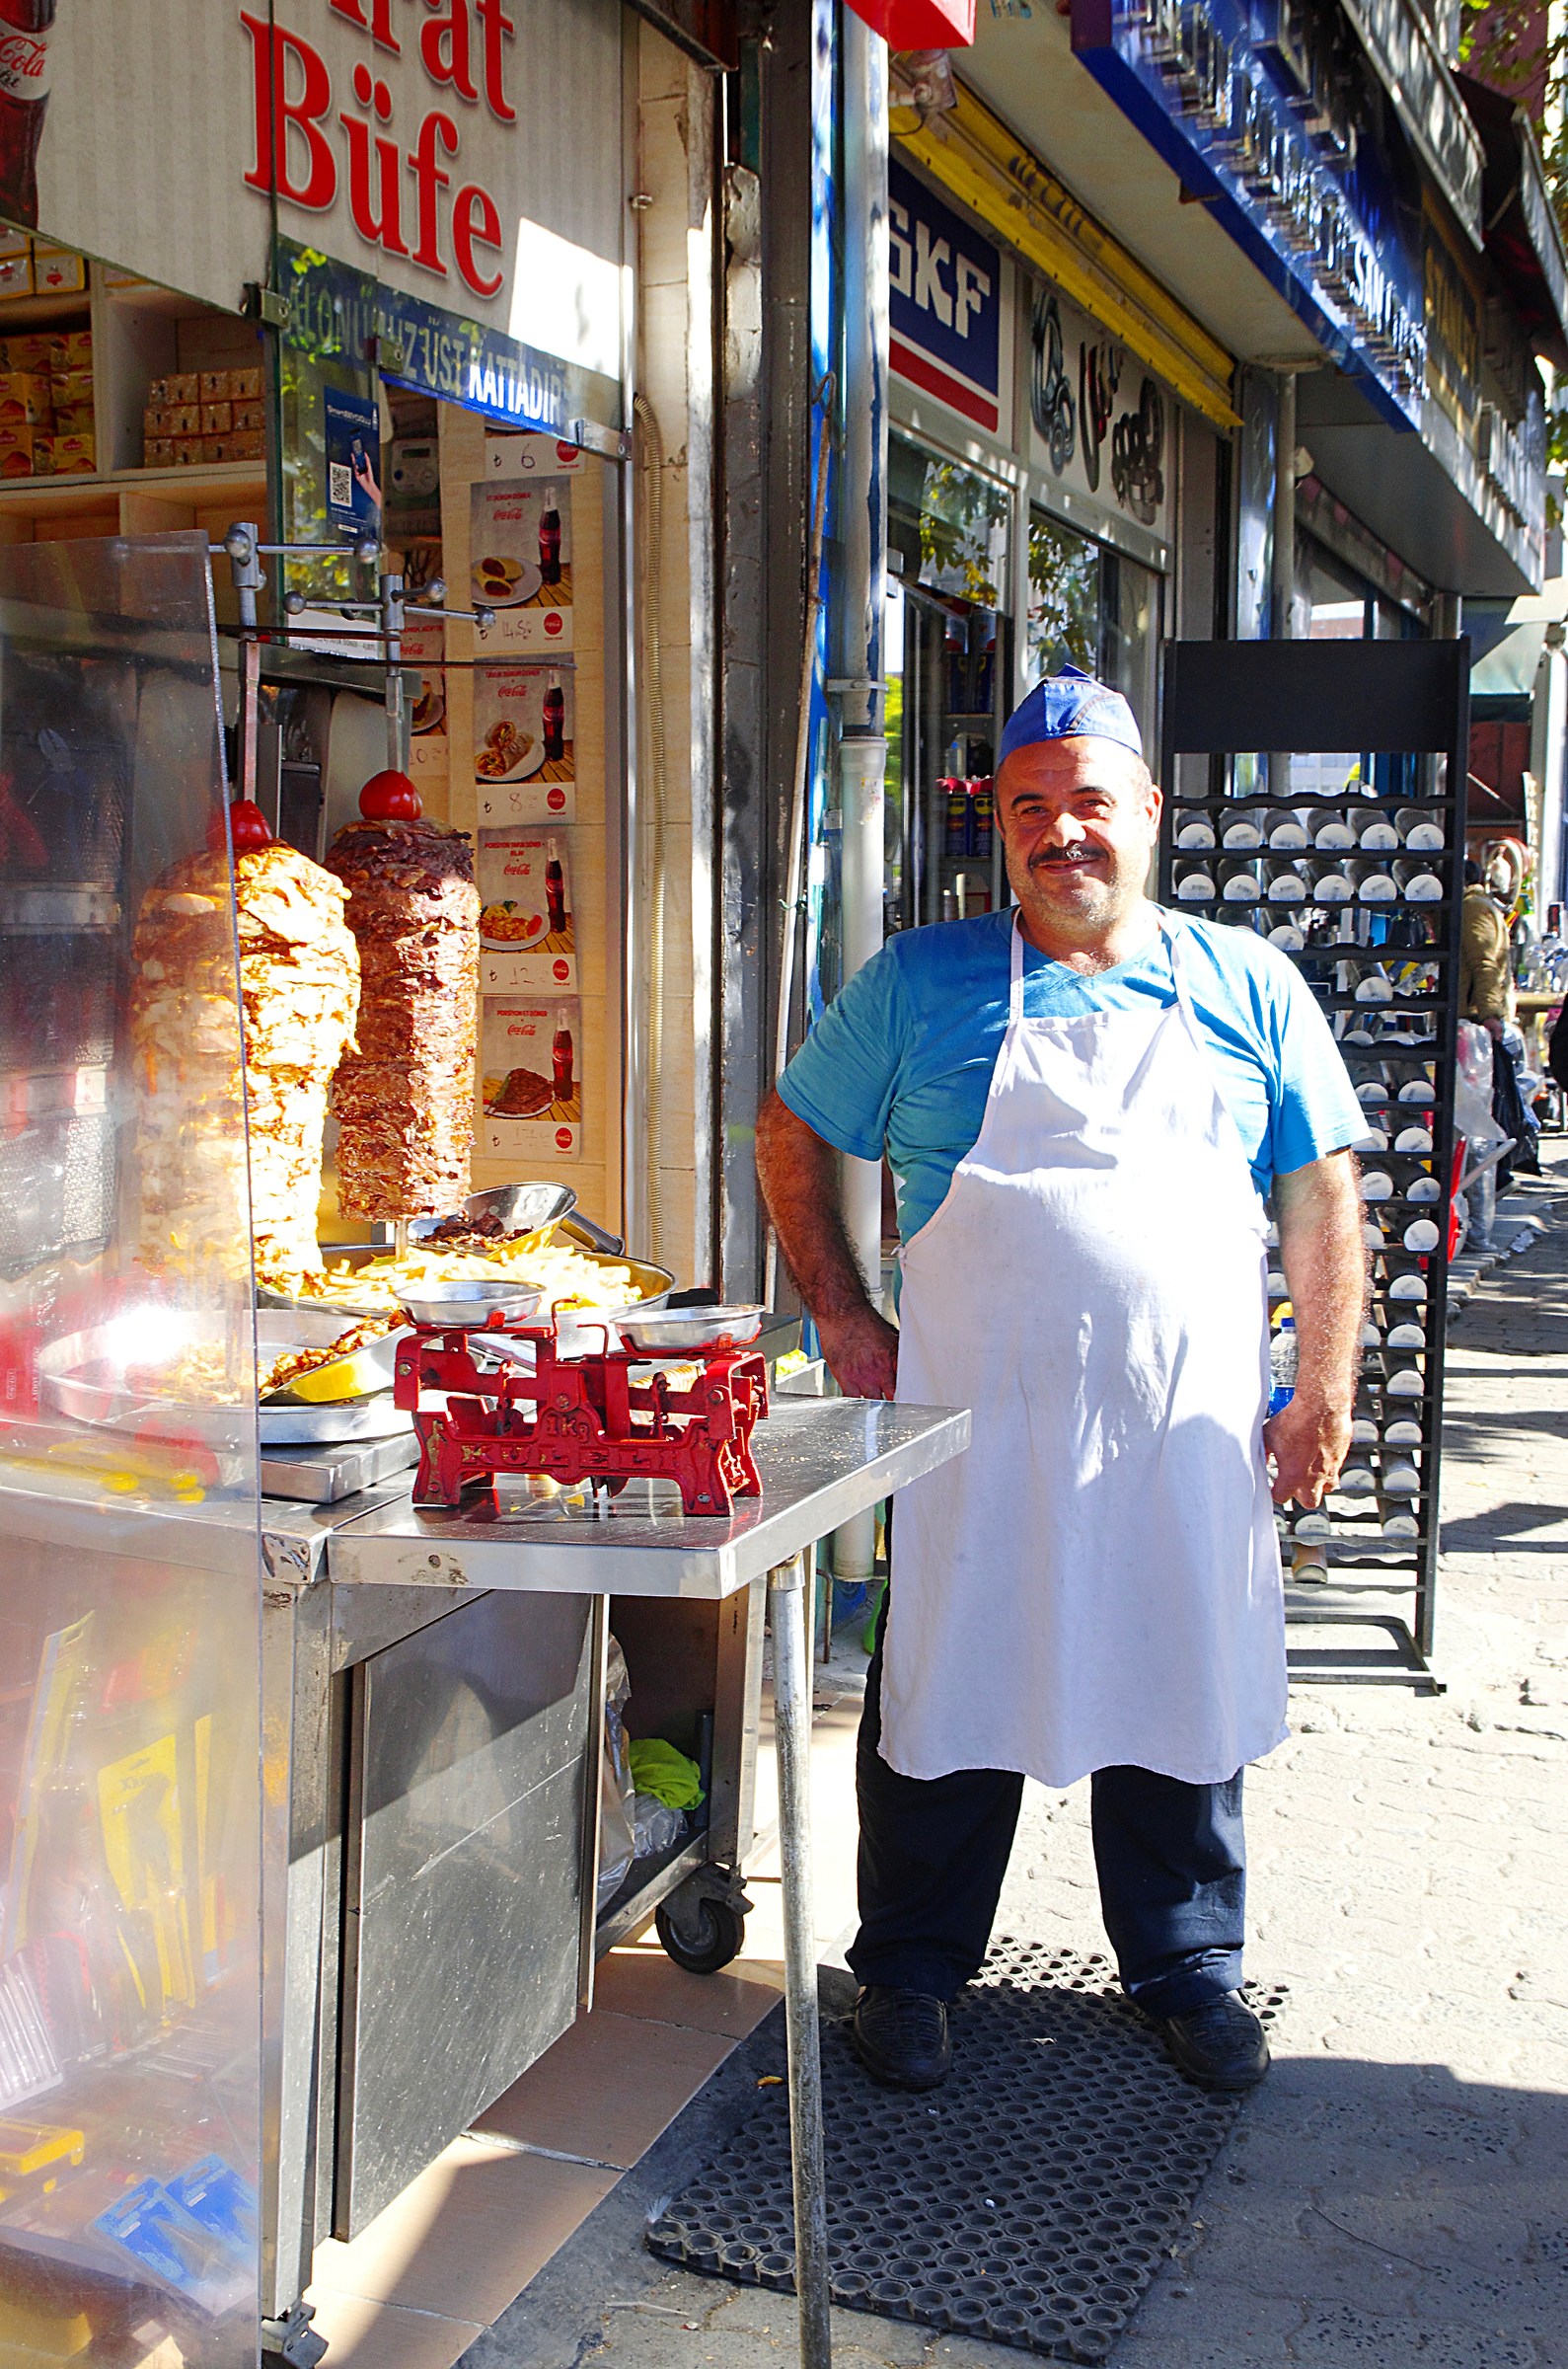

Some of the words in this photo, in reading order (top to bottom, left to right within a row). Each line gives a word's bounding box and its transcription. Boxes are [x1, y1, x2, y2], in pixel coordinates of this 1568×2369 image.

[241, 10, 503, 295] Büfe
[888, 194, 990, 339] SKF
[469, 347, 561, 426] KATTADIR
